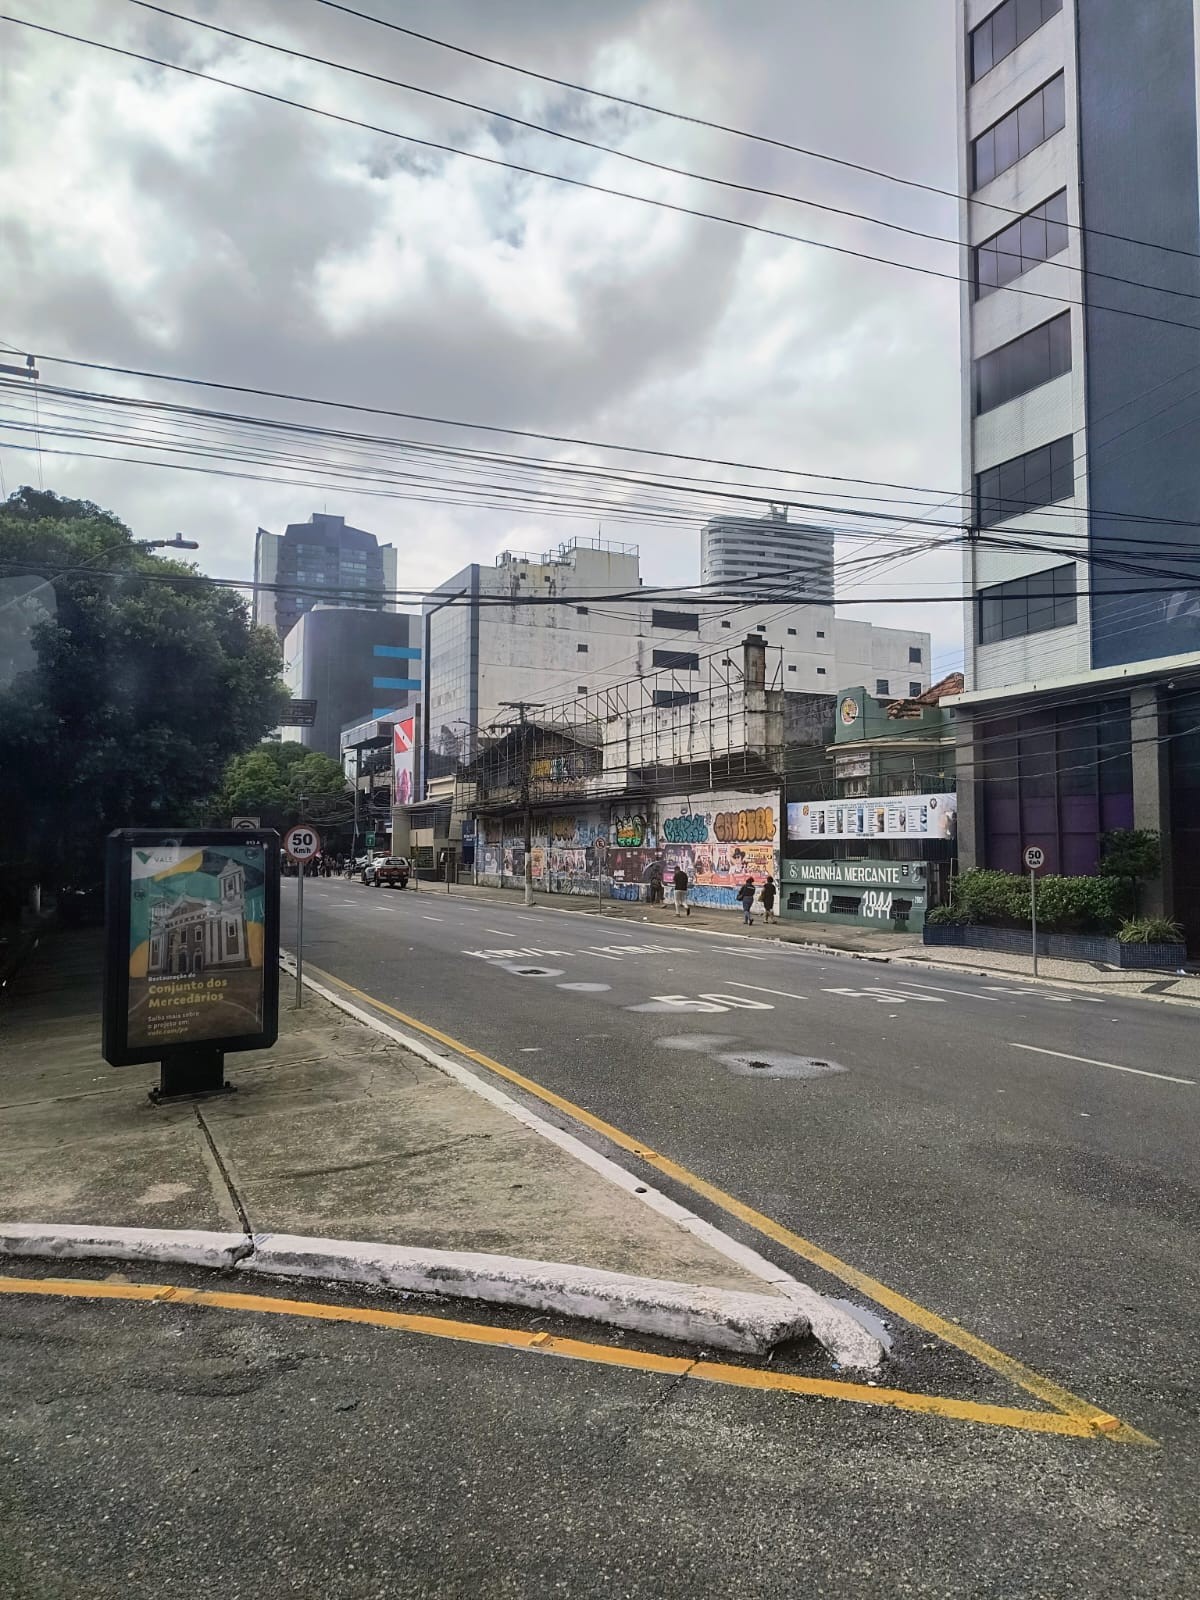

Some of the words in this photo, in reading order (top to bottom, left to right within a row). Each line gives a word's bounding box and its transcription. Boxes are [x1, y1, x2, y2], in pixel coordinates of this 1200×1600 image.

[292, 833, 313, 846] 50
[153, 856, 173, 864] VALE
[1028, 850, 1041, 859] 50
[801, 865, 842, 881] MARINHA
[844, 867, 900, 884] MERCANTE
[803, 887, 829, 914] FEB
[862, 890, 893, 920] 1944
[148, 982, 204, 995] Conjunto
[206, 977, 228, 988] dos
[148, 992, 224, 1009] Mercedários
[650, 993, 775, 1013] 50
[820, 987, 948, 1003] 50
[165, 1012, 181, 1020] mais
[153, 1021, 177, 1029] projeto
